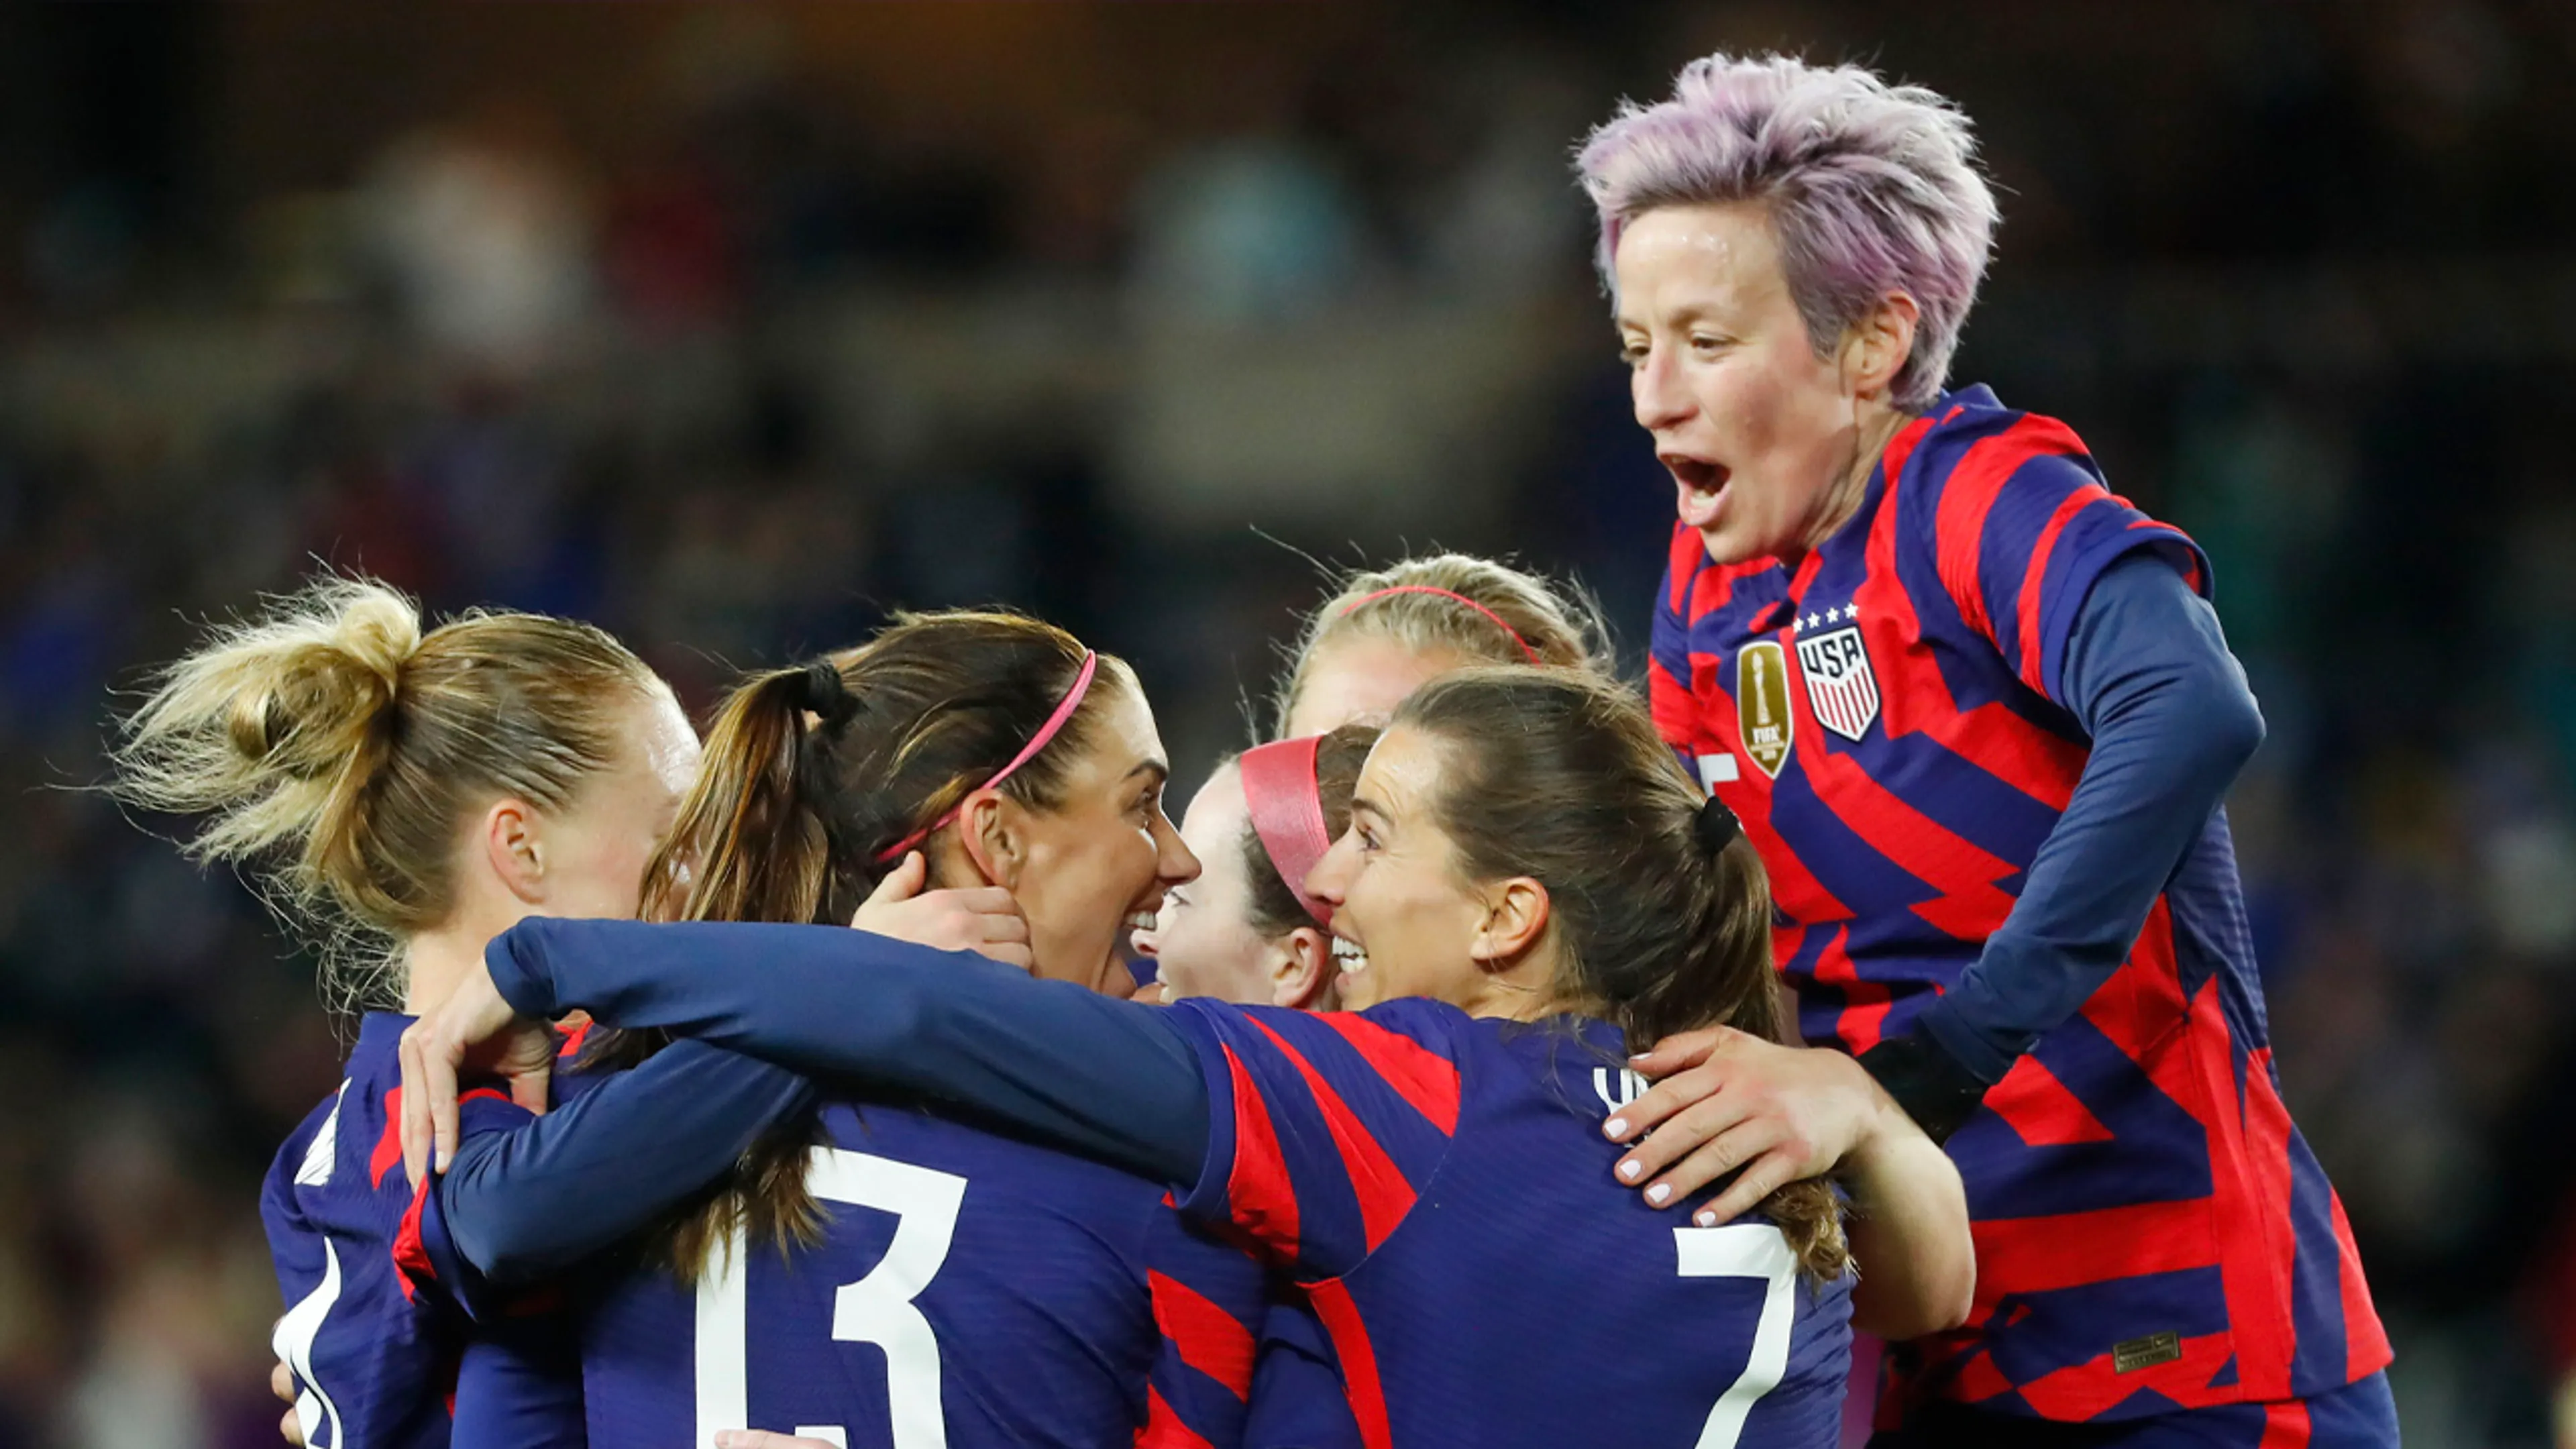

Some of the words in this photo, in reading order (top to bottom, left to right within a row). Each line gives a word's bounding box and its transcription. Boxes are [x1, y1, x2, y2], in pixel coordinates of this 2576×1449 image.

[1802, 633, 1860, 679] USA
[695, 1144, 968, 1449] 13
[1673, 1224, 1796, 1449] 7
